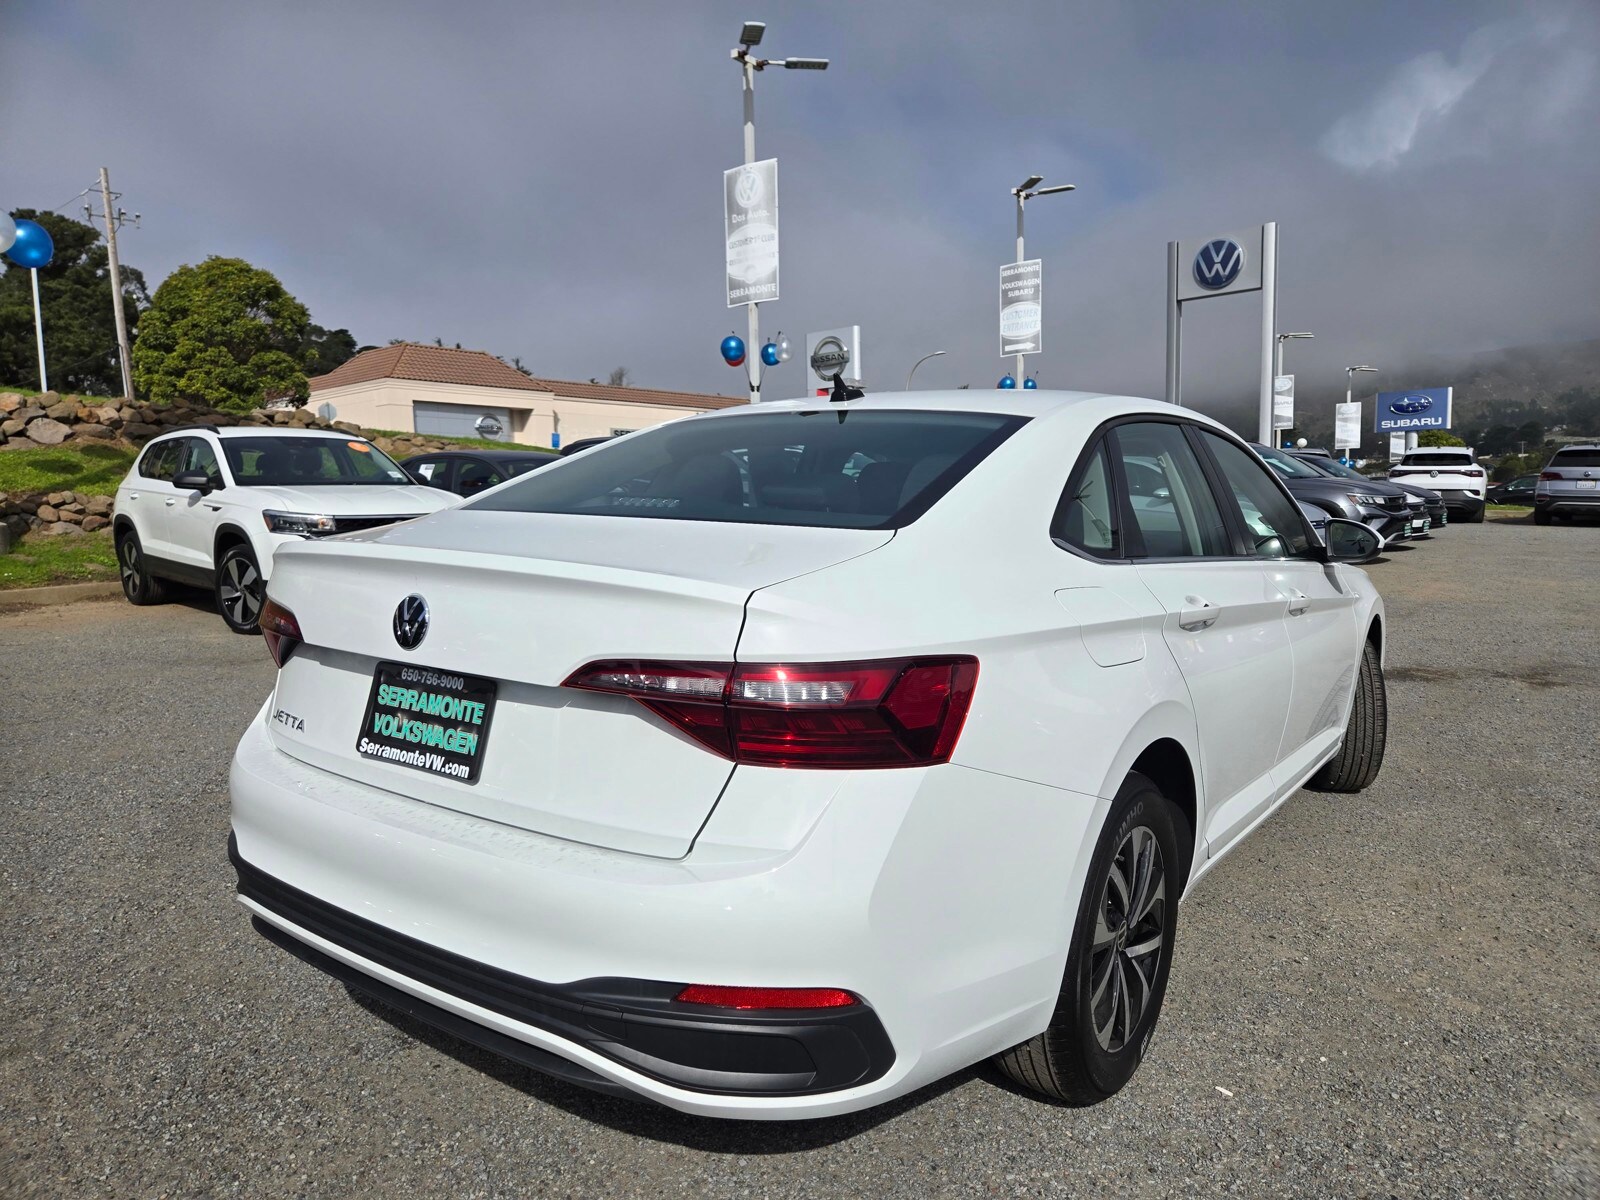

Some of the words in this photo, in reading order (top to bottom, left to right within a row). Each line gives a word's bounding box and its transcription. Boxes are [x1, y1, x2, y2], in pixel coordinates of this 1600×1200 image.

[1002, 265, 1039, 276] SERRAMONTE
[729, 283, 777, 299] SERRAMONTE
[1002, 278, 1039, 290] VOLKSWAGEN
[1008, 288, 1034, 297] SUBARU
[814, 352, 845, 364] NISSAN
[1381, 416, 1442, 429] SUBARU
[401, 668, 465, 691] 650-756-9000
[377, 683, 486, 725] SERRAMONTE
[273, 708, 305, 733] JETTA
[373, 712, 479, 756] VOLKSWAGEN
[359, 737, 470, 779] SerramonteVW.com
